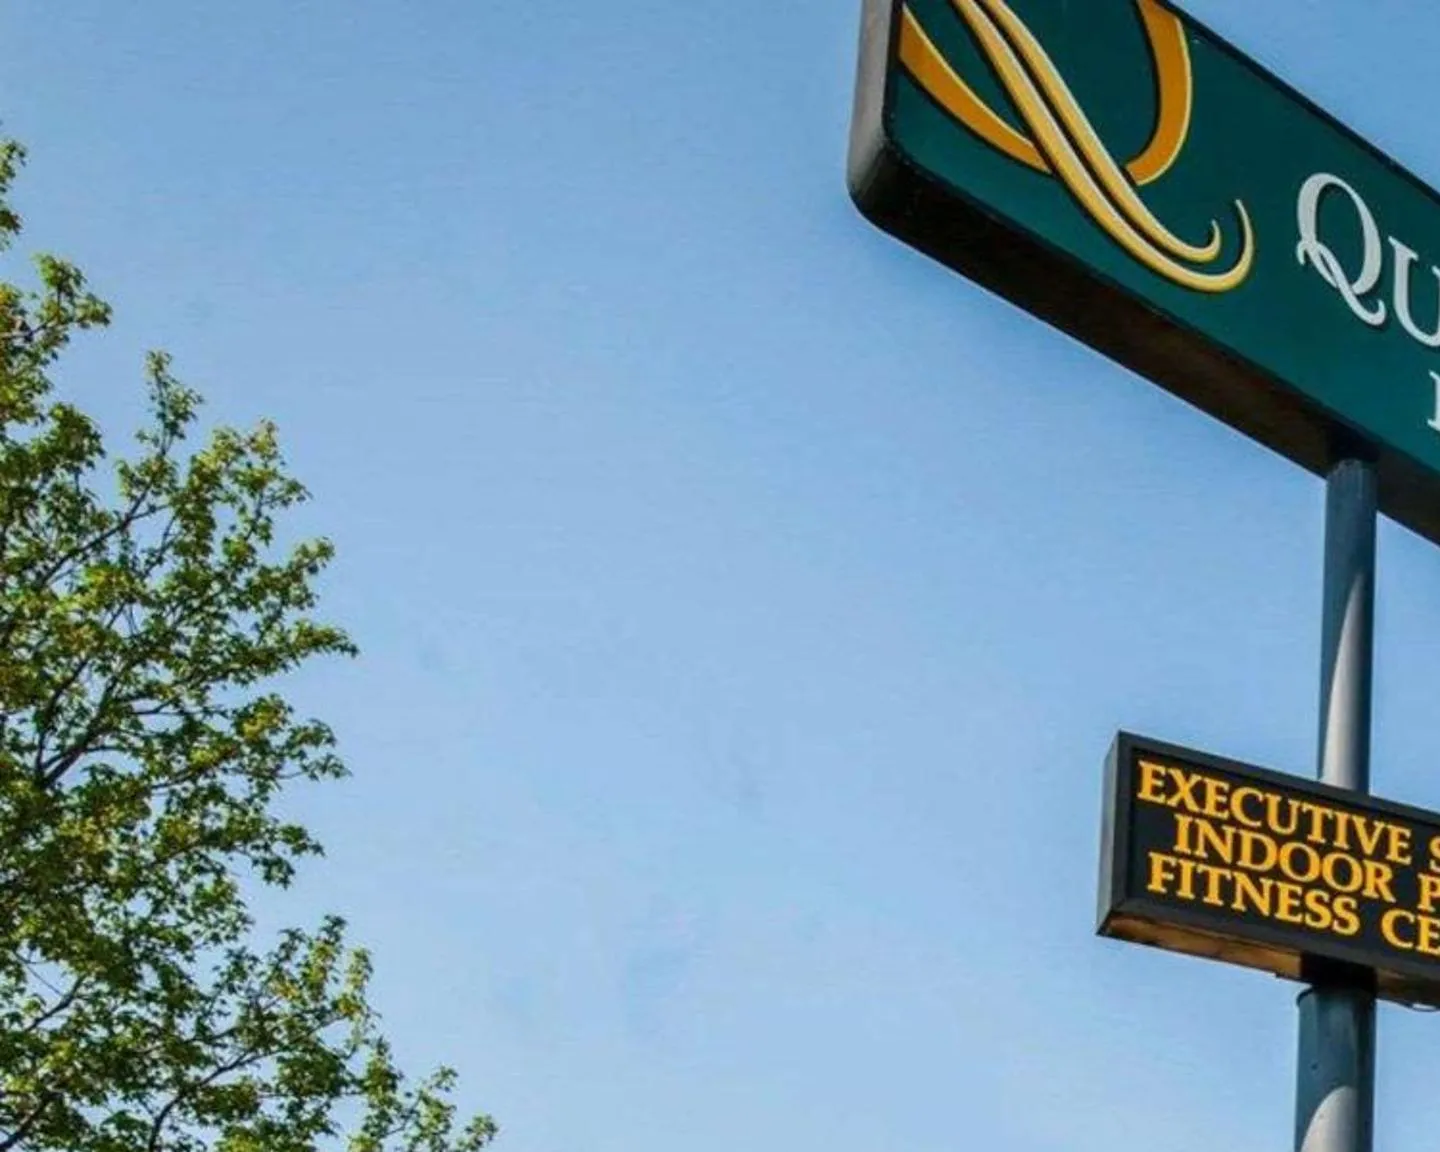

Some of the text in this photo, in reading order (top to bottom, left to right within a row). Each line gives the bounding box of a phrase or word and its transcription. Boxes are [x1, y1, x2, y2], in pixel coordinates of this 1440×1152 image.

[1137, 759, 1413, 866] EXECUTIVE
[1147, 852, 1361, 936] FITNESS
[1173, 813, 1397, 903] INDOOR
